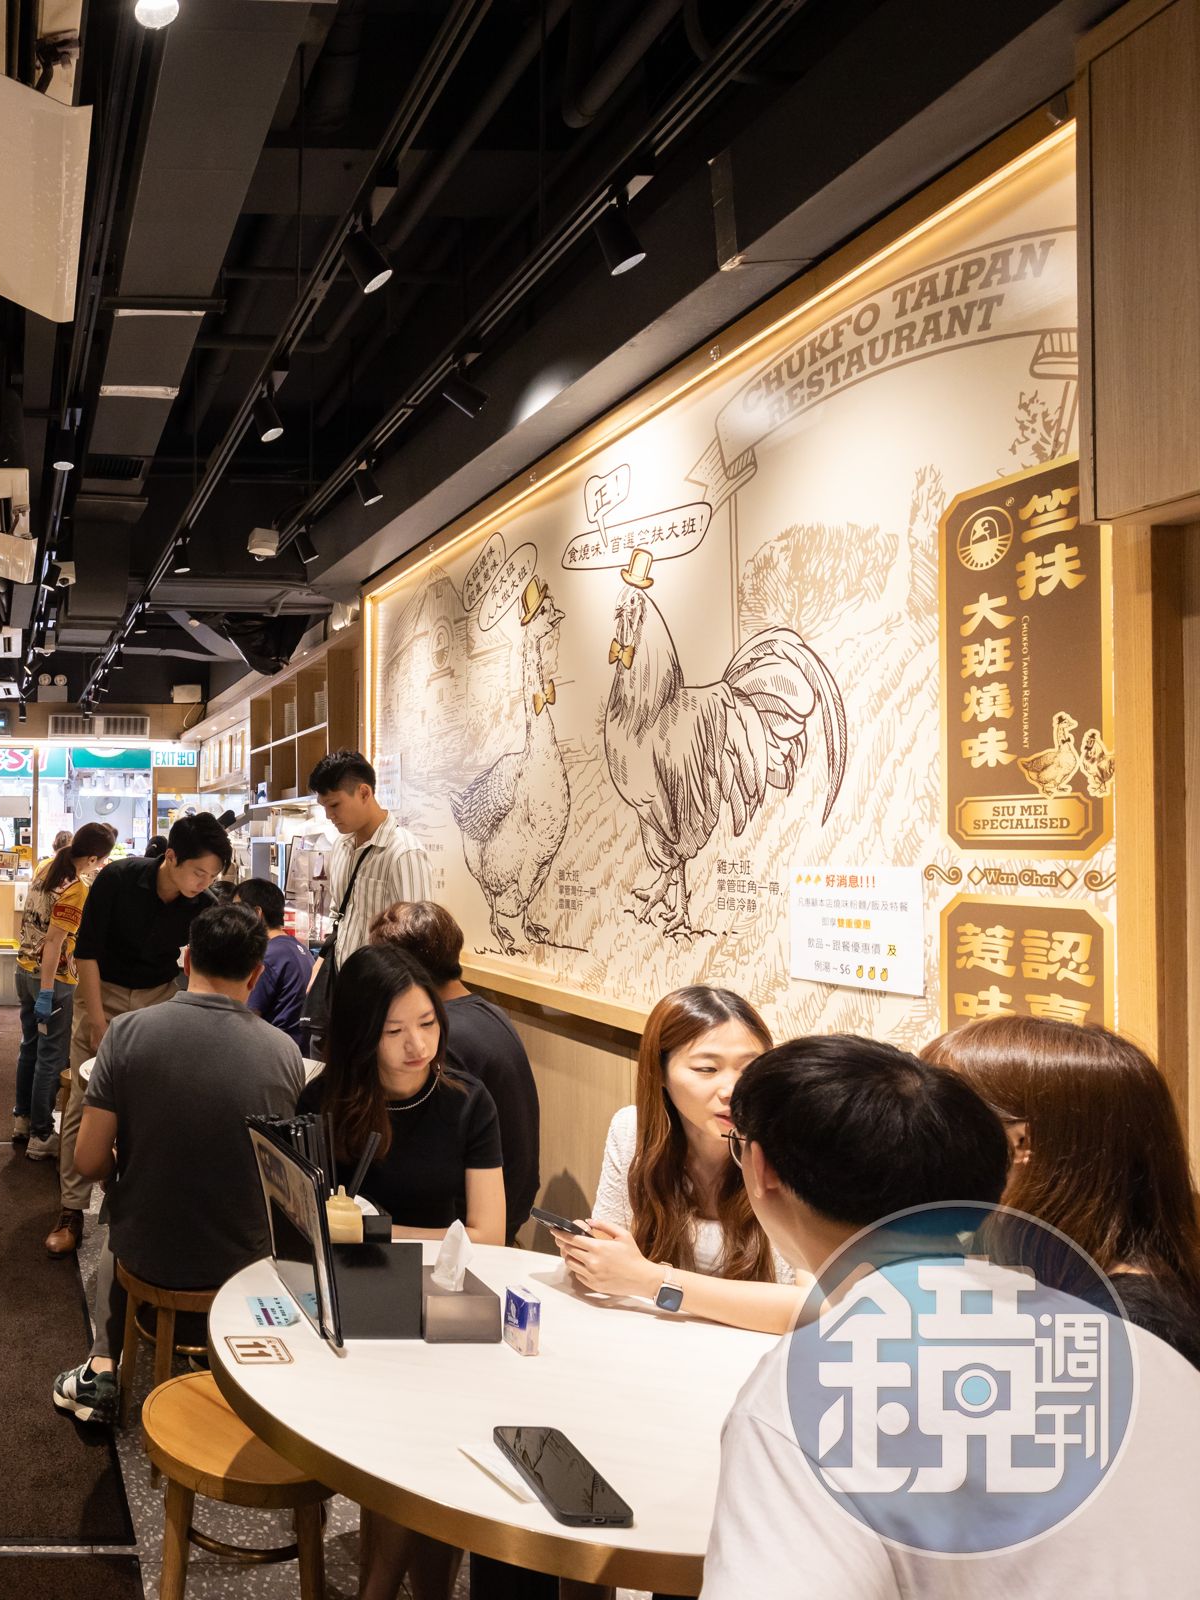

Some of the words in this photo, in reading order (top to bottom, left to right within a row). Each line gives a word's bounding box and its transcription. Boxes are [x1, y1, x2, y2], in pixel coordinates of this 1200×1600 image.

[742, 302, 880, 414] CHUKFO
[892, 238, 1056, 320] TAIPAN
[767, 293, 1004, 430] RESTAURANT
[1016, 486, 1087, 600] 竺扶
[960, 592, 1017, 768] 大班燒味
[1022, 690, 1030, 749] RESTAURANT
[155, 751, 175, 766] EXIT
[177, 751, 195, 766] 出口
[973, 817, 1070, 830] SPECIALISED
[992, 806, 1017, 817] SIU
[1020, 805, 1048, 816] MEI
[825, 874, 876, 889] 好消息!!!
[984, 868, 1018, 886] Wan
[1019, 868, 1057, 887] Chai
